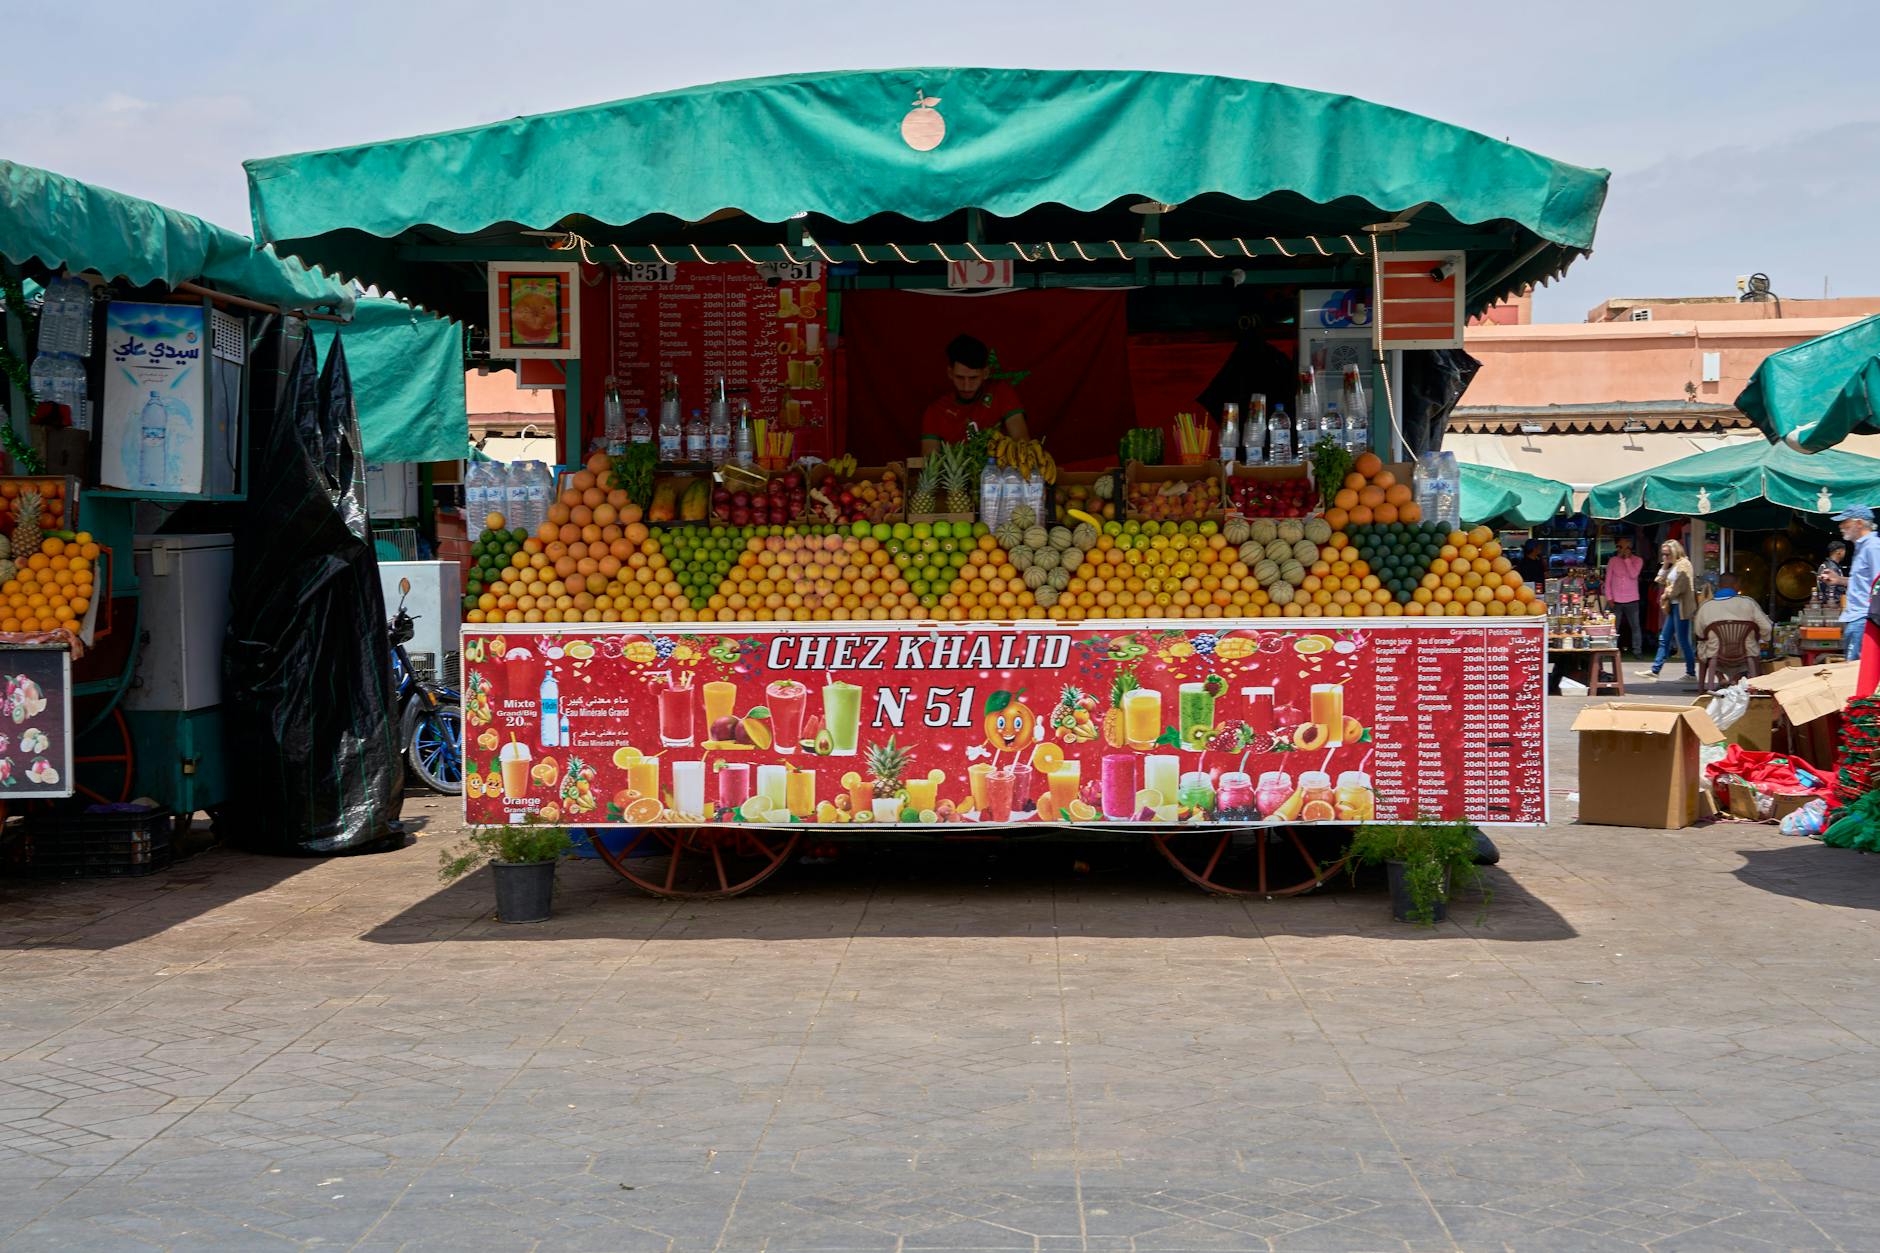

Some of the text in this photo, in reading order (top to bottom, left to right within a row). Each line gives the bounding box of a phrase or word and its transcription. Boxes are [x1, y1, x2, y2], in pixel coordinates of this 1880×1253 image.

[726, 292, 747, 300] 10dh
[726, 301, 747, 309] 10dh
[726, 311, 747, 319] 10dh
[726, 320, 747, 328] 10dh
[726, 329, 747, 337] 10dh
[112, 336, 199, 365] سيدي علي
[1488, 628, 1522, 636] Petit/Small
[1375, 637, 1456, 646] Orange juice Jus d'orange
[766, 634, 1073, 671] CHEZ KHALID
[1463, 646, 1485, 654] 20dh
[1488, 646, 1510, 654] 10dh
[1463, 655, 1485, 663] 20dh
[1488, 655, 1510, 663] 10dh
[1375, 665, 1510, 674] Apple Pomme 20dh 10dh
[1375, 674, 1510, 682] Banana Banane 20dh 10dh
[1463, 683, 1485, 691] 20dh
[1488, 683, 1510, 691] 10dh
[567, 695, 584, 707] كبير
[1375, 693, 1510, 701] Prunes Pruneaux 20dh 10dh
[503, 699, 536, 709] Mixte
[871, 686, 976, 728] N 51
[1375, 703, 1510, 712] Ginger Gingembre 20dh 10dh
[496, 709, 538, 718] Grand/Big
[566, 707, 630, 717] Eau Minérale Grand
[505, 716, 525, 727] 20
[1463, 713, 1485, 722] 20dh
[1488, 713, 1510, 722] 10dh
[1463, 722, 1485, 731] 20dh
[1488, 722, 1510, 731] 10dh
[1463, 731, 1485, 739] 20dh
[1488, 731, 1510, 739] 10dh
[577, 739, 589, 747] Eau
[615, 739, 630, 747] Petit
[1375, 741, 1402, 749] Avocado
[1417, 741, 1440, 749] Avocat
[1463, 741, 1485, 749] 20dh
[1375, 750, 1510, 760] Papaya Papaye 20dh 10dh
[1375, 760, 1406, 769] Pineapple
[1463, 759, 1485, 767] 20dh
[1488, 759, 1510, 767] 10dh
[1375, 769, 1510, 777] Grenade Grenade 30dh 15dh
[1375, 778, 1510, 788] Pastique Pastique 20dh 10dh
[1463, 787, 1485, 795] 20dh
[1488, 787, 1510, 795] 10dh
[502, 797, 541, 807] Orange
[1417, 796, 1437, 804] Fraise
[1463, 796, 1485, 804] 20dh
[1488, 796, 1510, 804] 10dh
[503, 807, 541, 815] Grand/Big
[1375, 804, 1397, 813] Mango
[1463, 804, 1485, 812] 20dh
[1375, 812, 1399, 821] Dragon
[1488, 811, 1510, 820] 15dh
